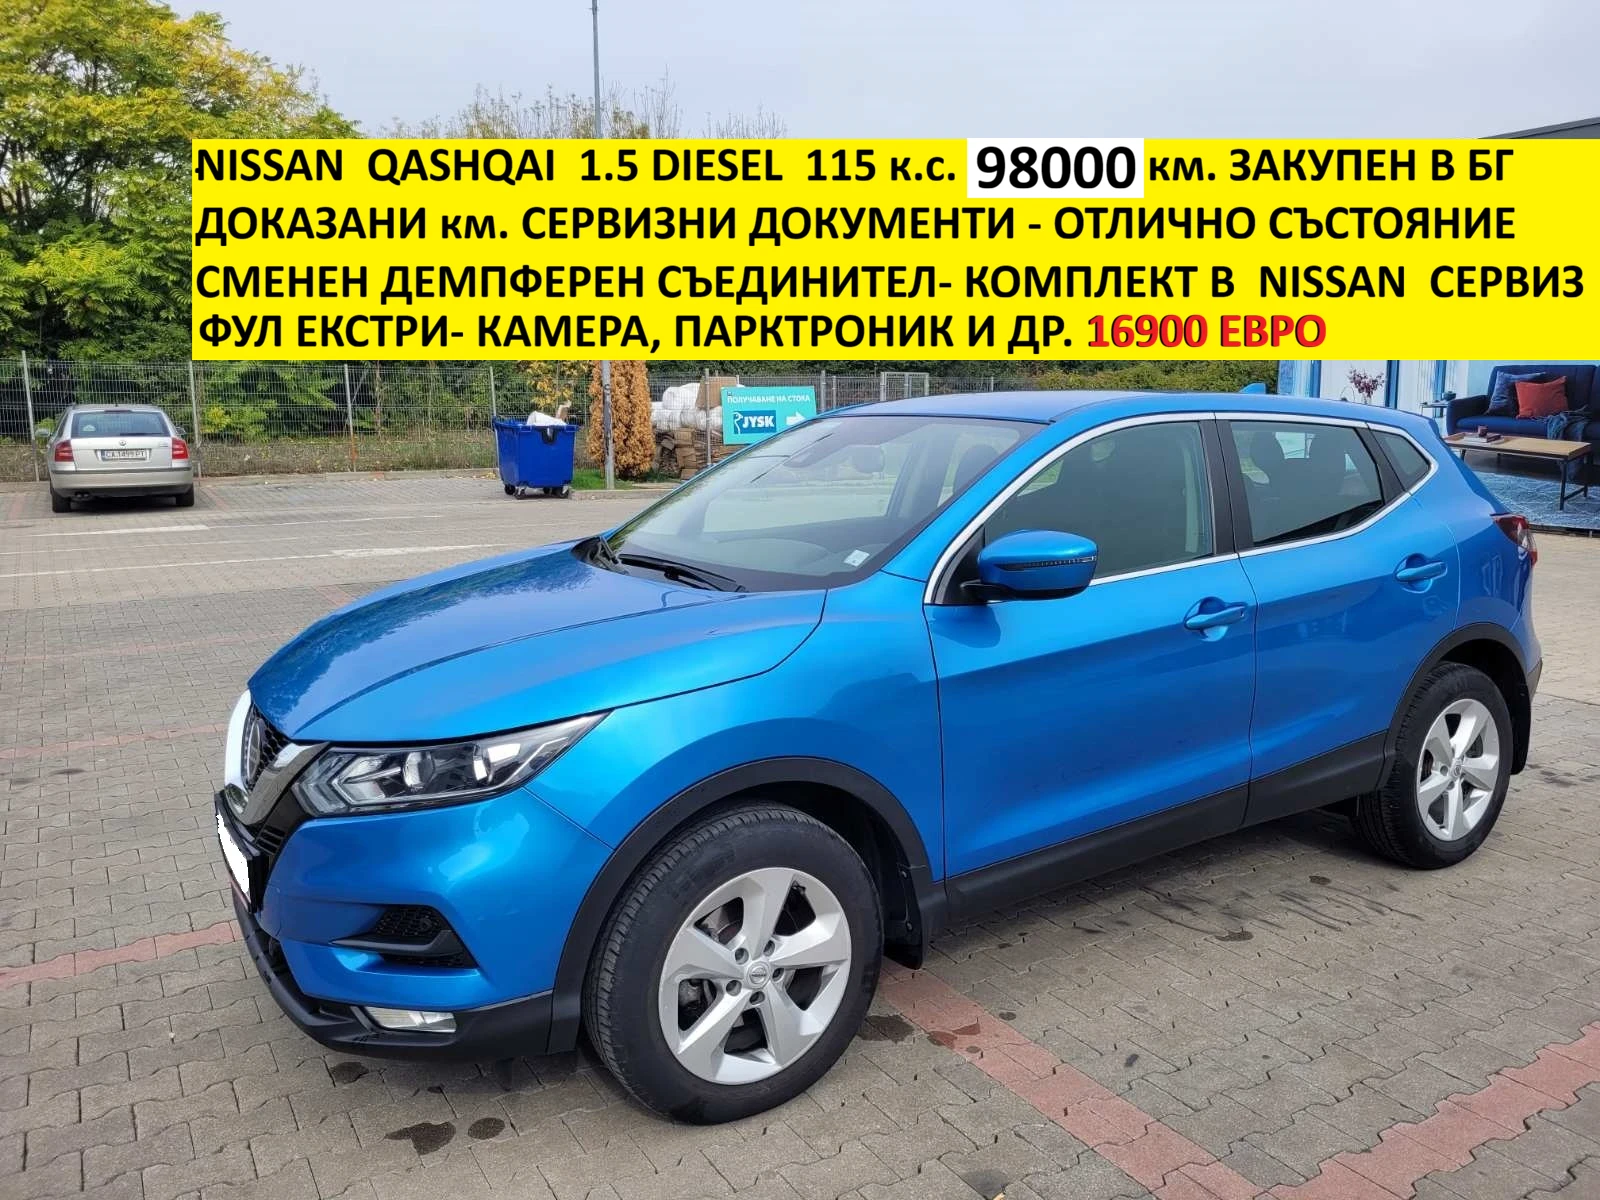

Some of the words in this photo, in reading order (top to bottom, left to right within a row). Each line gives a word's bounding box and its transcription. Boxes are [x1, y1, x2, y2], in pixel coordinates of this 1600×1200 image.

[727, 395, 776, 404] ПОЛУЧАВАНЕ
[777, 395, 787, 403] НА
[788, 394, 810, 402] СТОКА
[742, 416, 775, 428] JYSK
